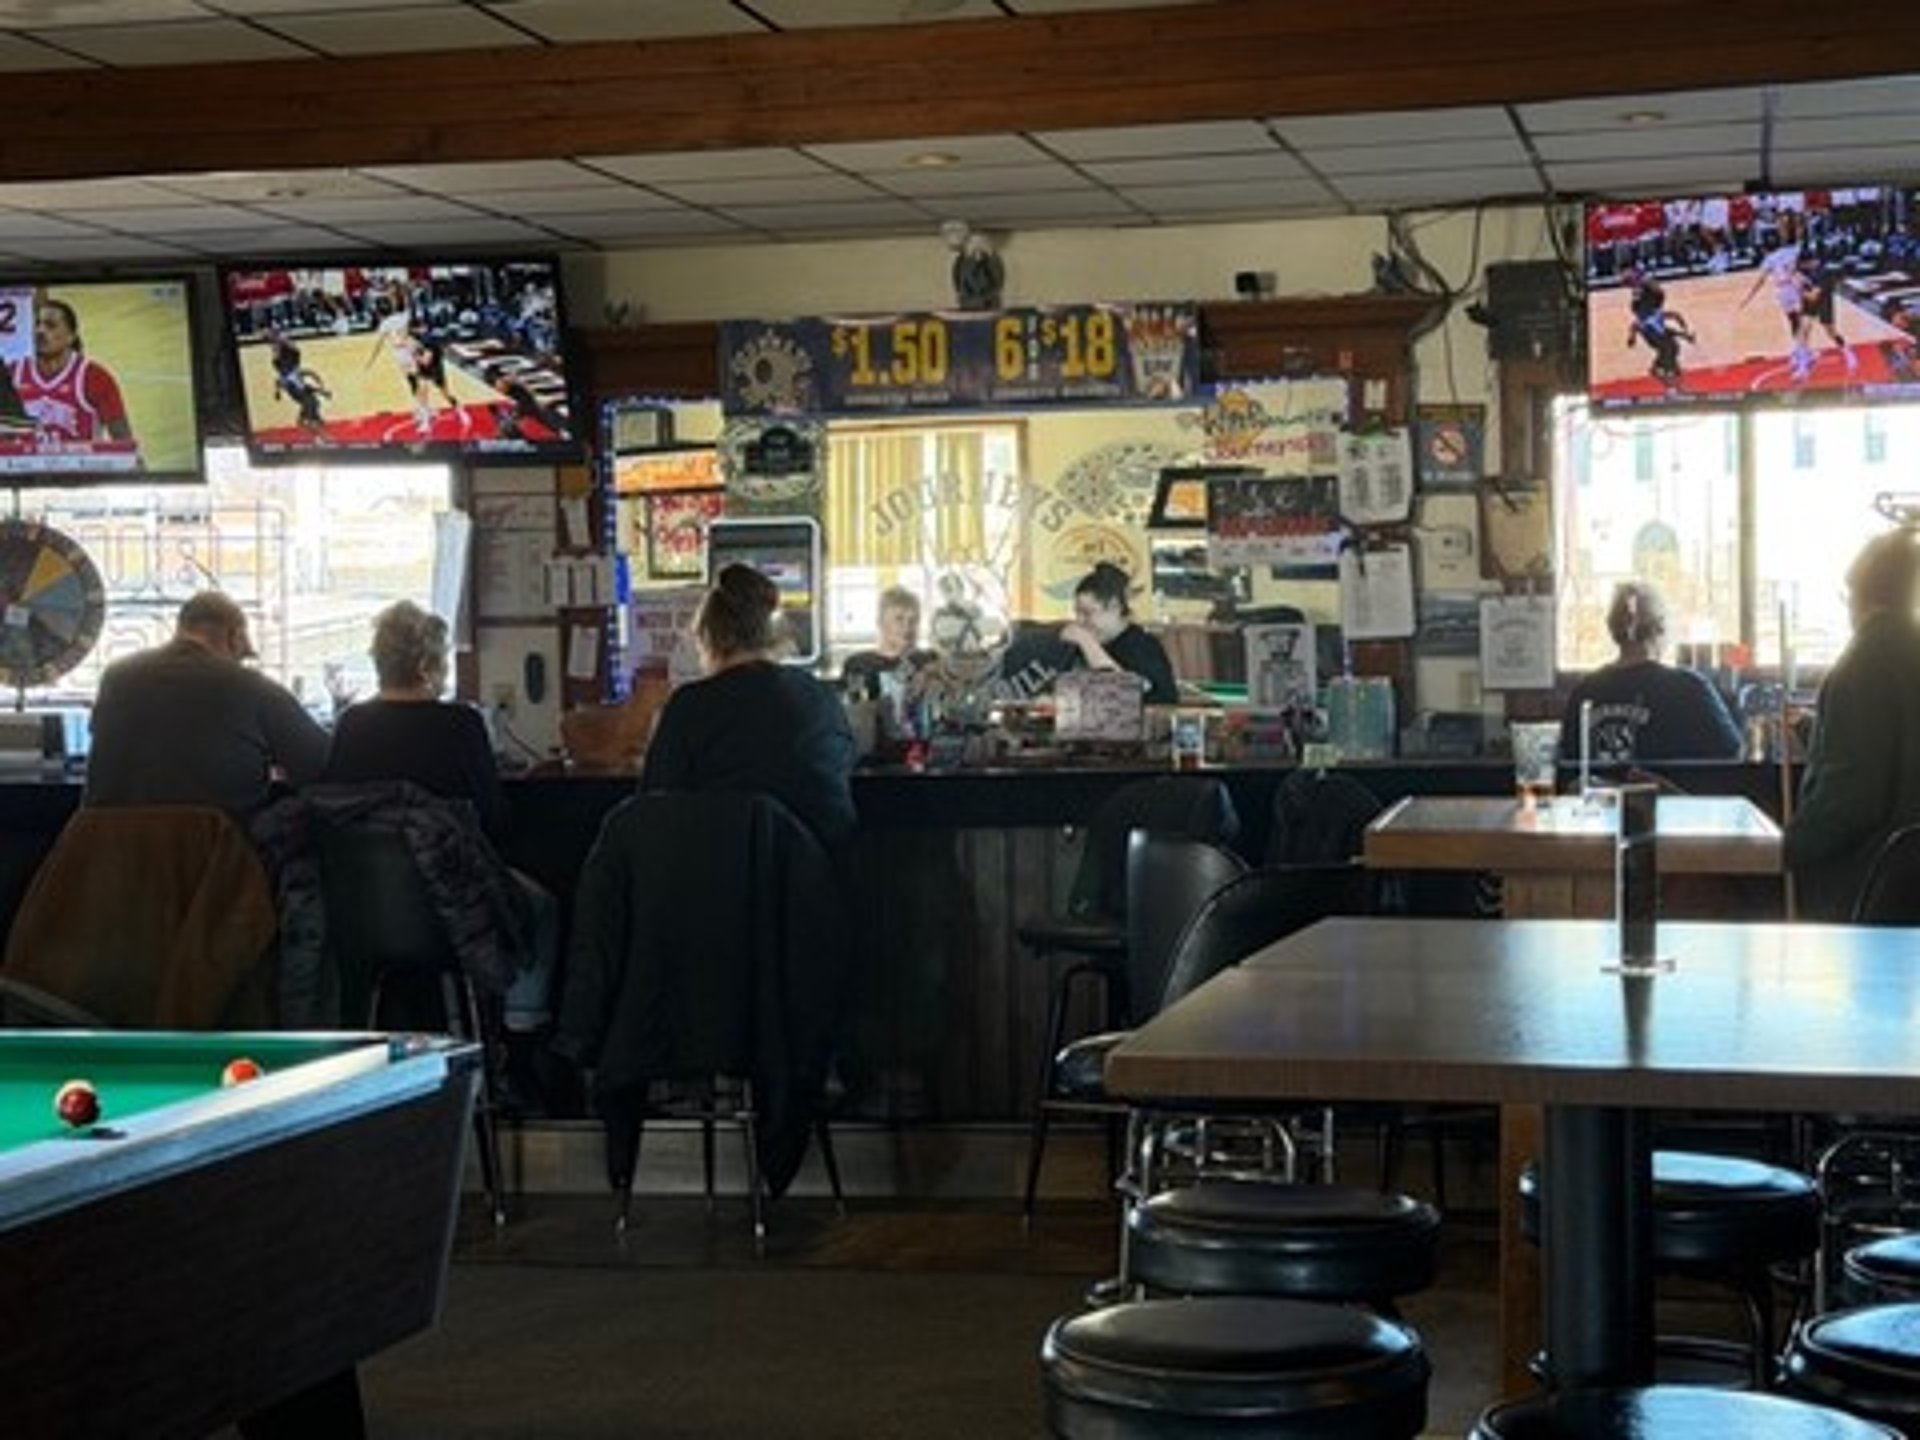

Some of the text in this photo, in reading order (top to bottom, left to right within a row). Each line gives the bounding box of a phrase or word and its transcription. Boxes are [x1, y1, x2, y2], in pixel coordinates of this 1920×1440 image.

[831, 320, 949, 385] $1.50
[994, 317, 1024, 382] 6
[1040, 310, 1116, 379] $18
